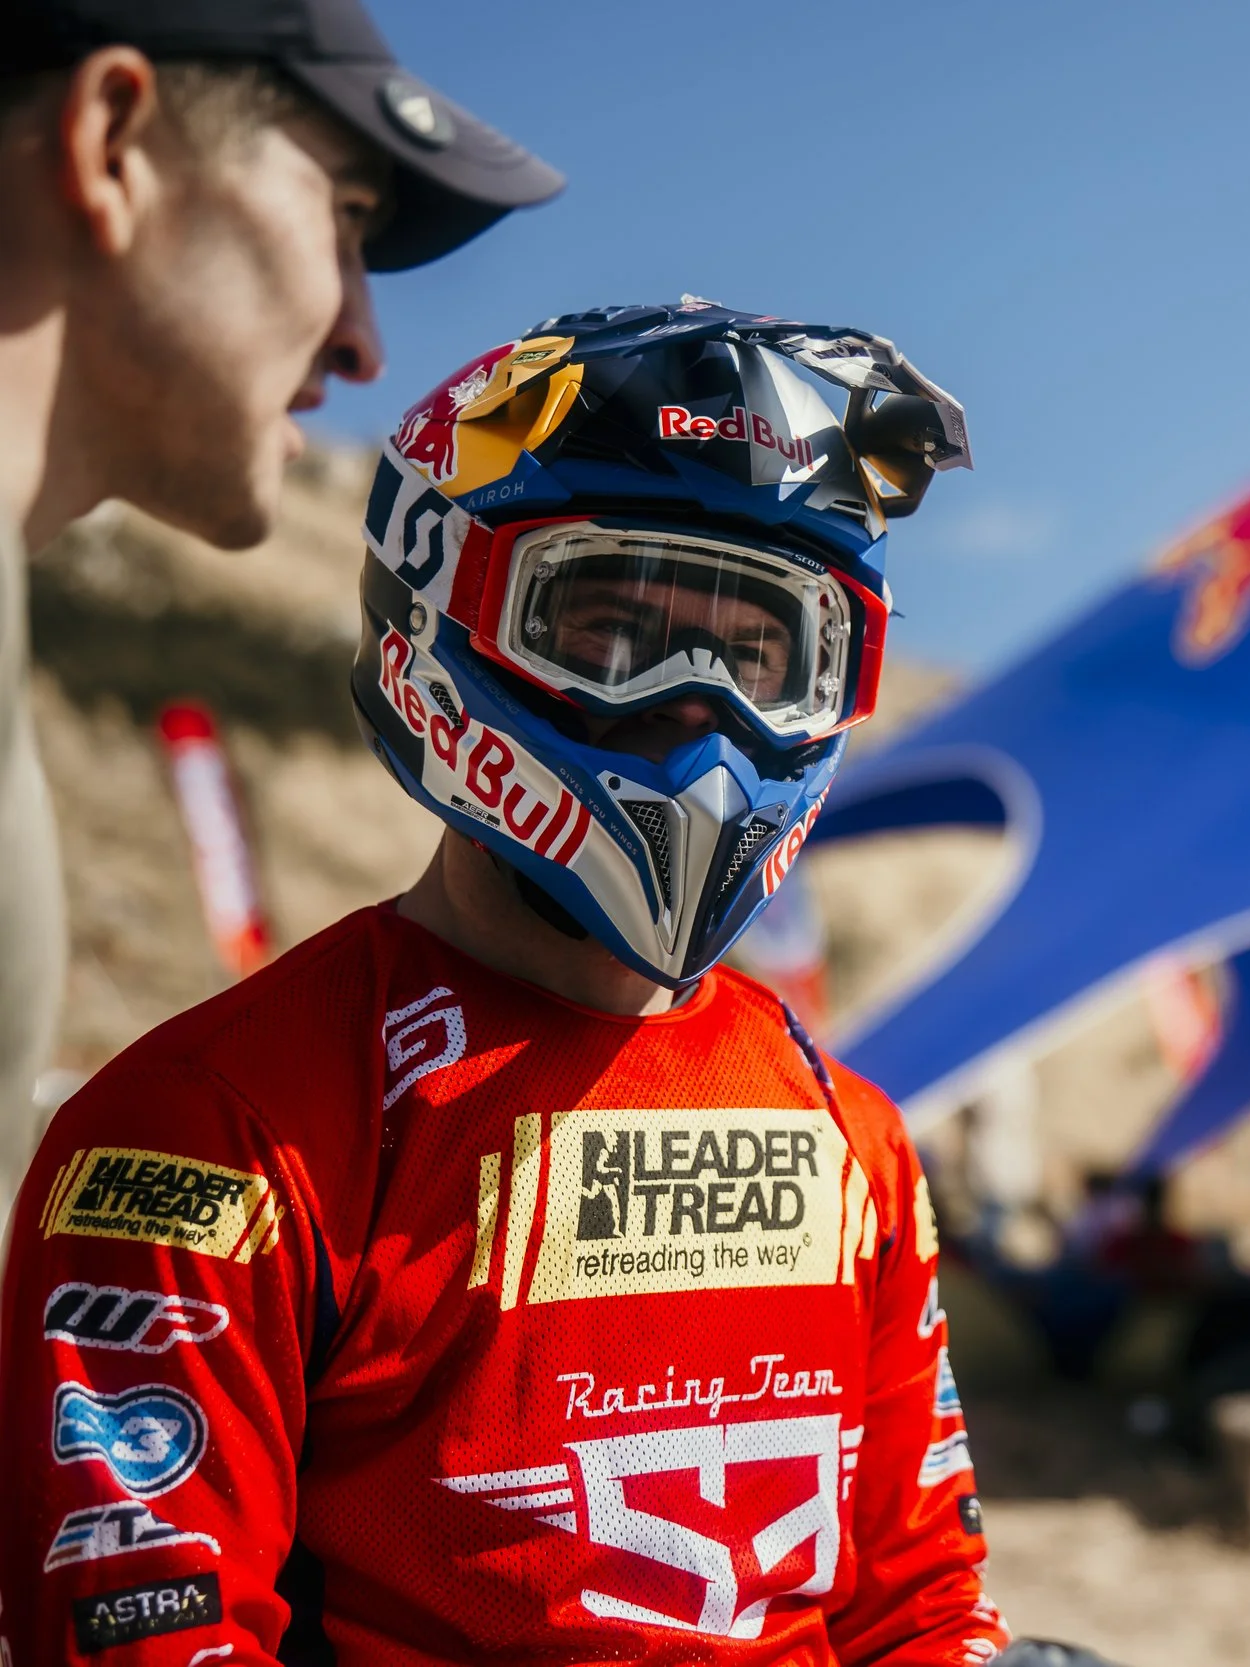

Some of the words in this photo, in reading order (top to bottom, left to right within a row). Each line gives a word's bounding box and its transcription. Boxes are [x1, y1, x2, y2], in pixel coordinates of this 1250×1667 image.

[659, 406, 747, 441] Red
[751, 412, 814, 471] Bull
[465, 481, 525, 509] AIROH
[381, 628, 471, 773] Red
[465, 725, 592, 867] Bull
[560, 768, 584, 795] GIVES
[588, 798, 606, 819] YOU
[610, 822, 638, 856] WINGS
[633, 1129, 819, 1181] LEADER
[114, 1157, 247, 1206] LEADER
[66, 1214, 140, 1235] retreading
[143, 1219, 171, 1237] the
[174, 1226, 207, 1245] way
[108, 1187, 221, 1228] TREAD
[633, 1181, 806, 1237] TREAD
[576, 1243, 705, 1278] retreading
[714, 1242, 749, 1269] the
[757, 1244, 802, 1273] way
[557, 1366, 728, 1420] Racing
[742, 1354, 843, 1400] Team
[89, 1583, 208, 1626] ASTRA
